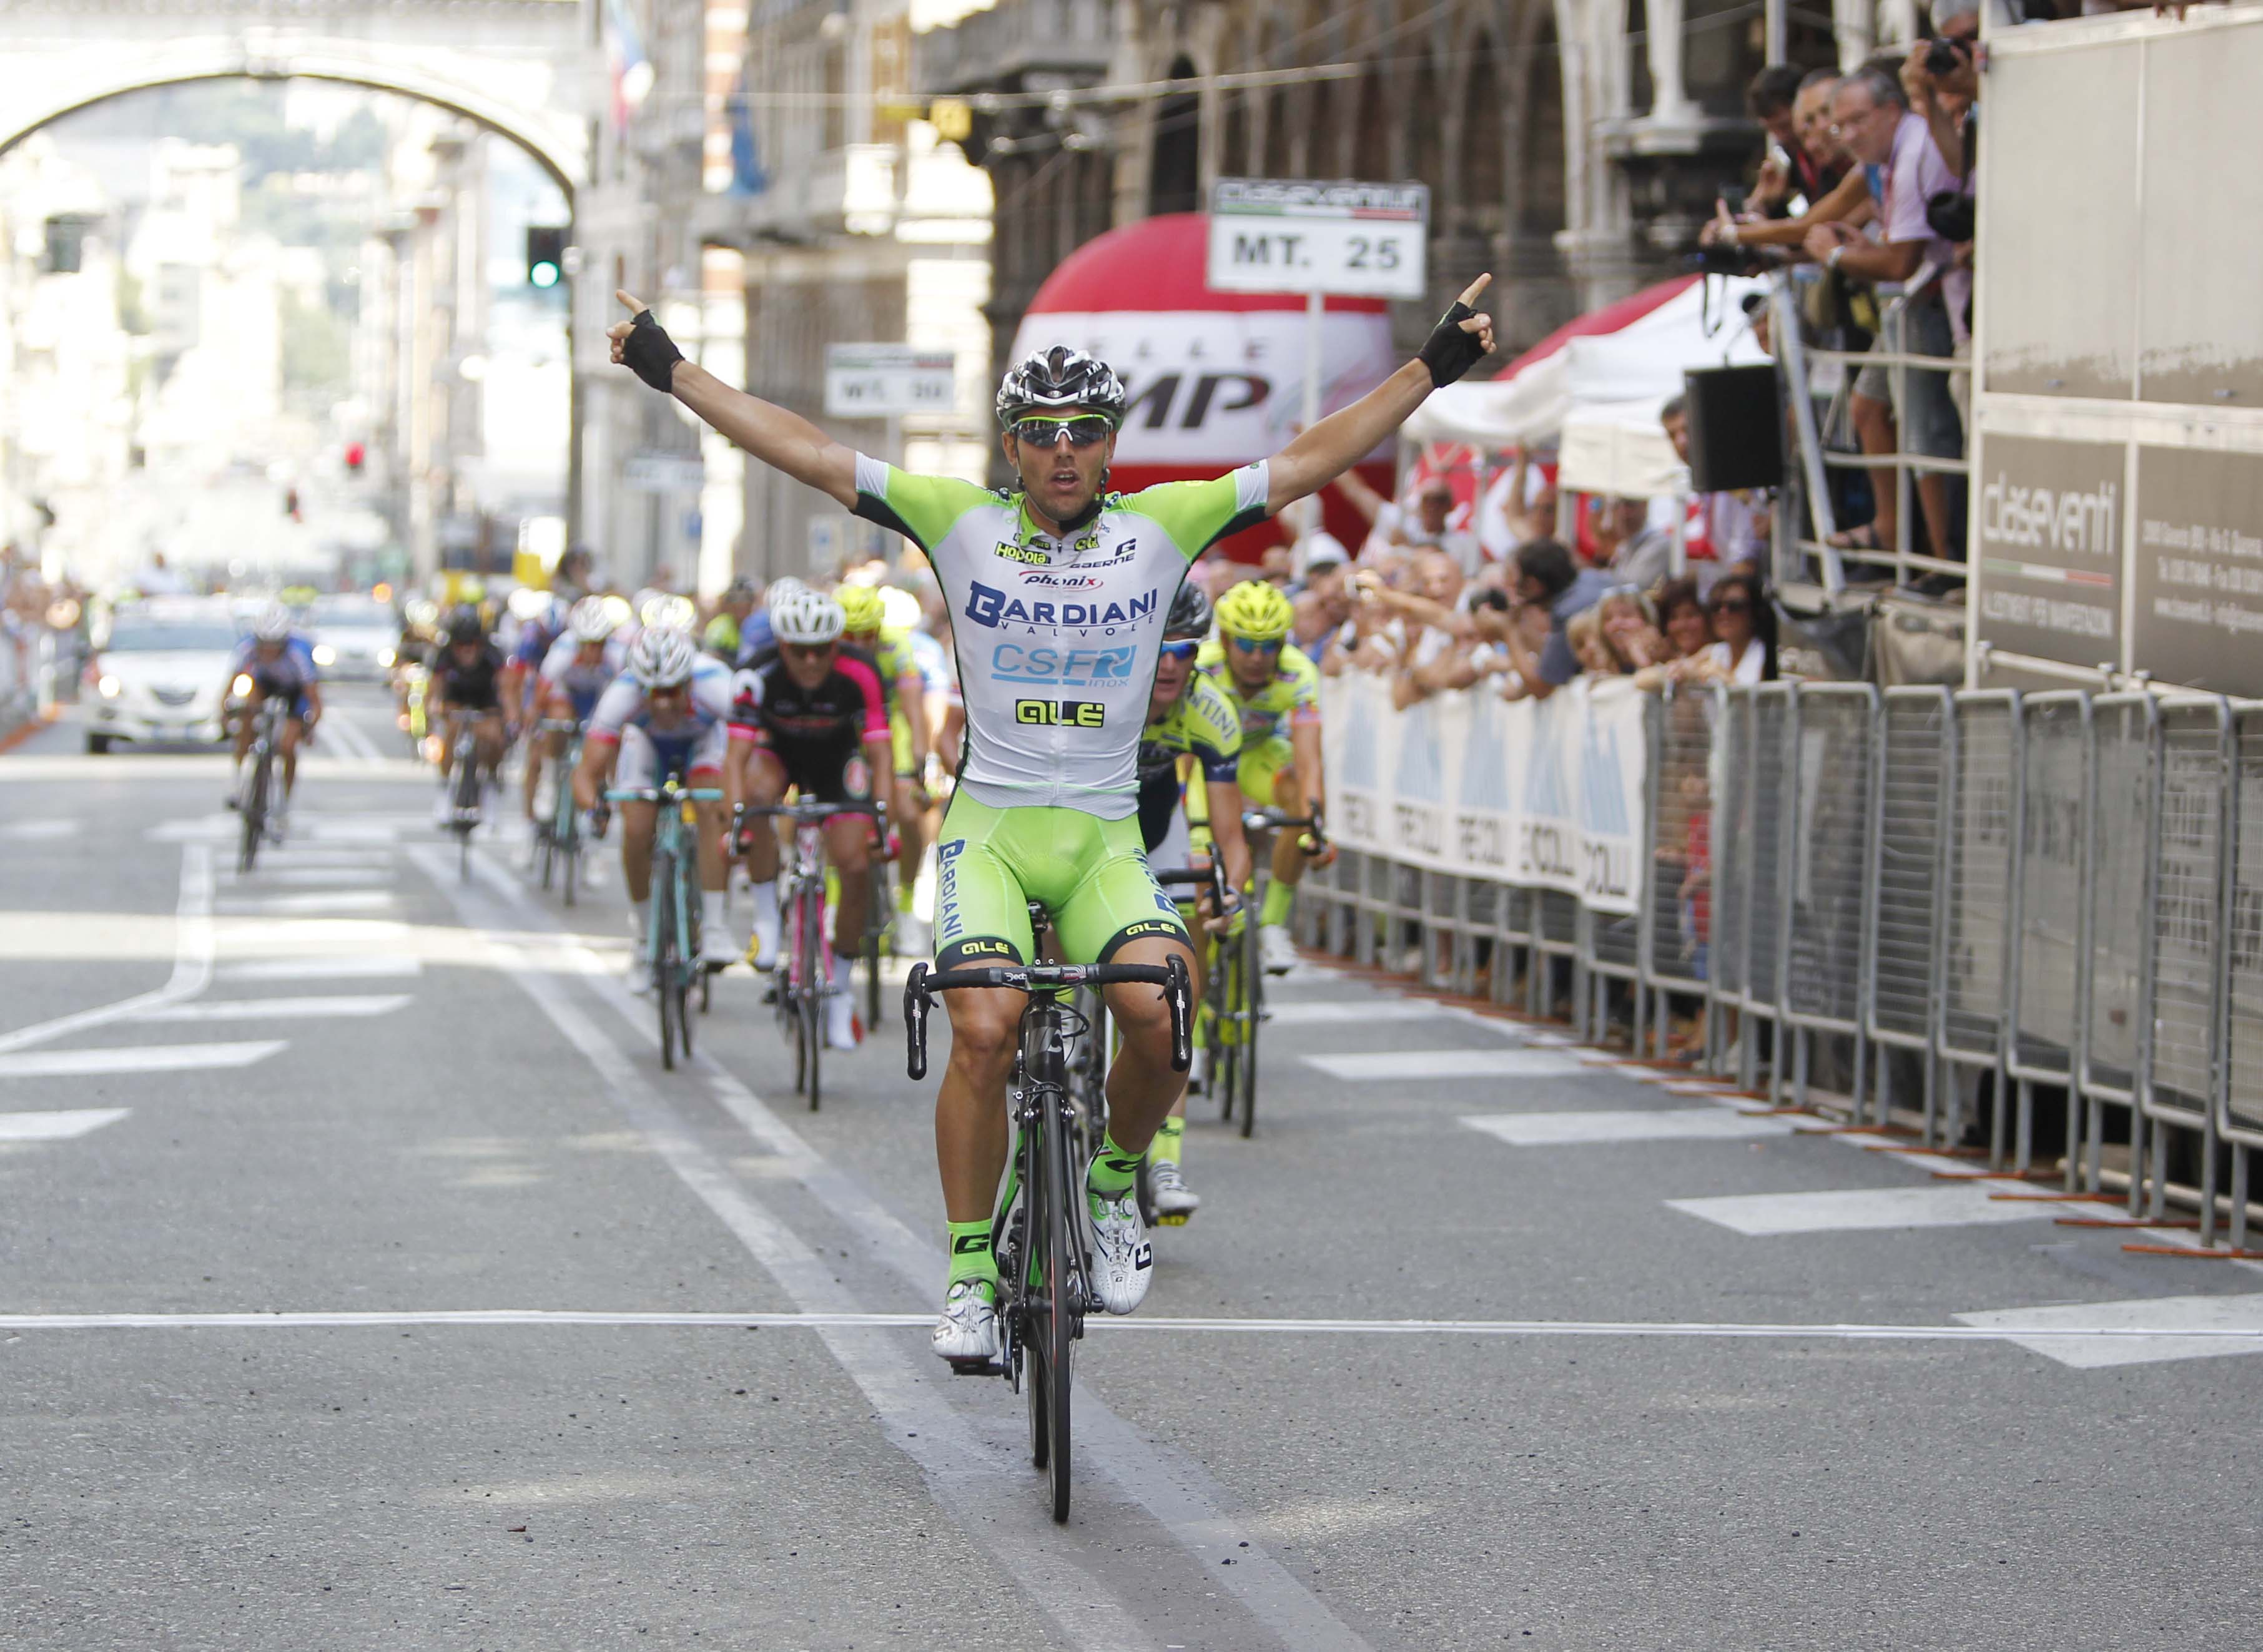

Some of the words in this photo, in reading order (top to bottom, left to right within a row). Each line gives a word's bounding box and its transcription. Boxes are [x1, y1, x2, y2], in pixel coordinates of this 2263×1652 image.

[1233, 233, 1311, 265] MT.
[1346, 235, 1400, 268] 25
[1085, 337, 1268, 358] ELLE
[965, 580, 1158, 628] BARDIANI
[1000, 612, 1154, 637] VALVOLE
[991, 643, 1100, 676] CSF
[939, 838, 965, 940] BARDIANI
